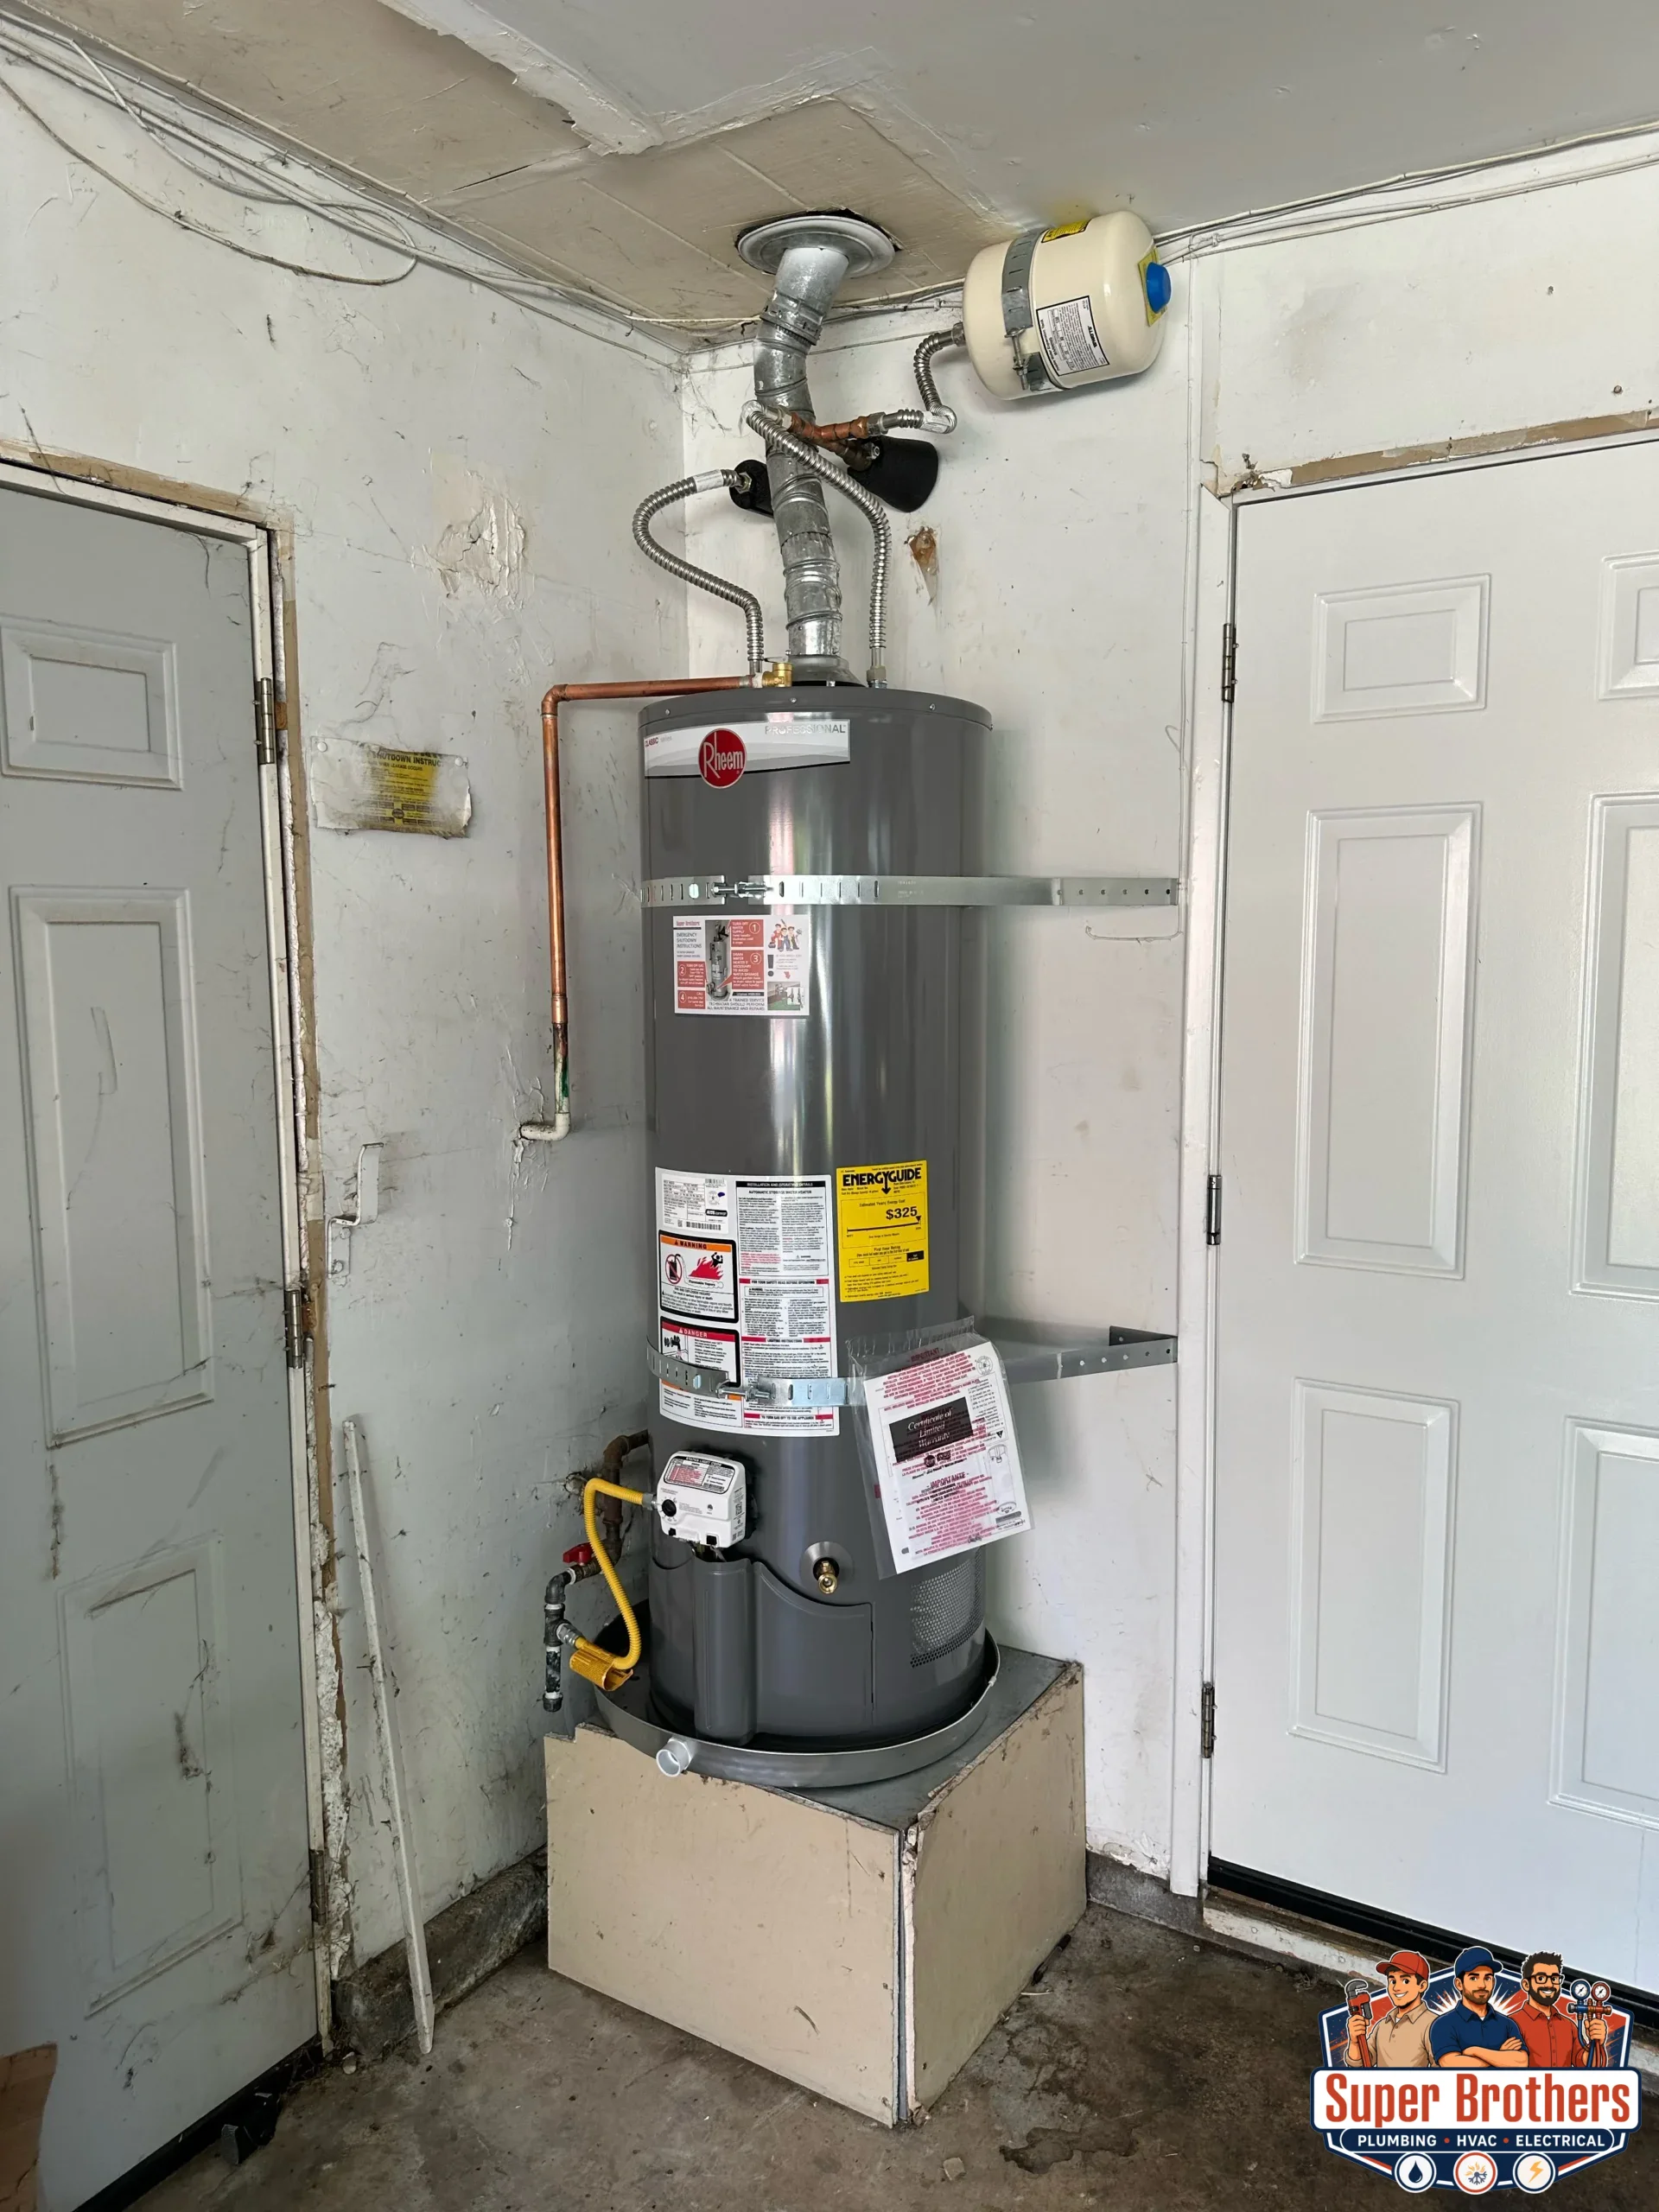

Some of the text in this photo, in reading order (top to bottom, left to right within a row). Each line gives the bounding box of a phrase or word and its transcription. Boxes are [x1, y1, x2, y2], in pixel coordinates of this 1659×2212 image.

[703, 731, 745, 779] Rheem
[842, 1167, 922, 1187] ENERGYGUIDE
[886, 1206, 918, 1220] $325
[680, 1241, 707, 1249] WARNING
[683, 1329, 708, 1338] DANGER
